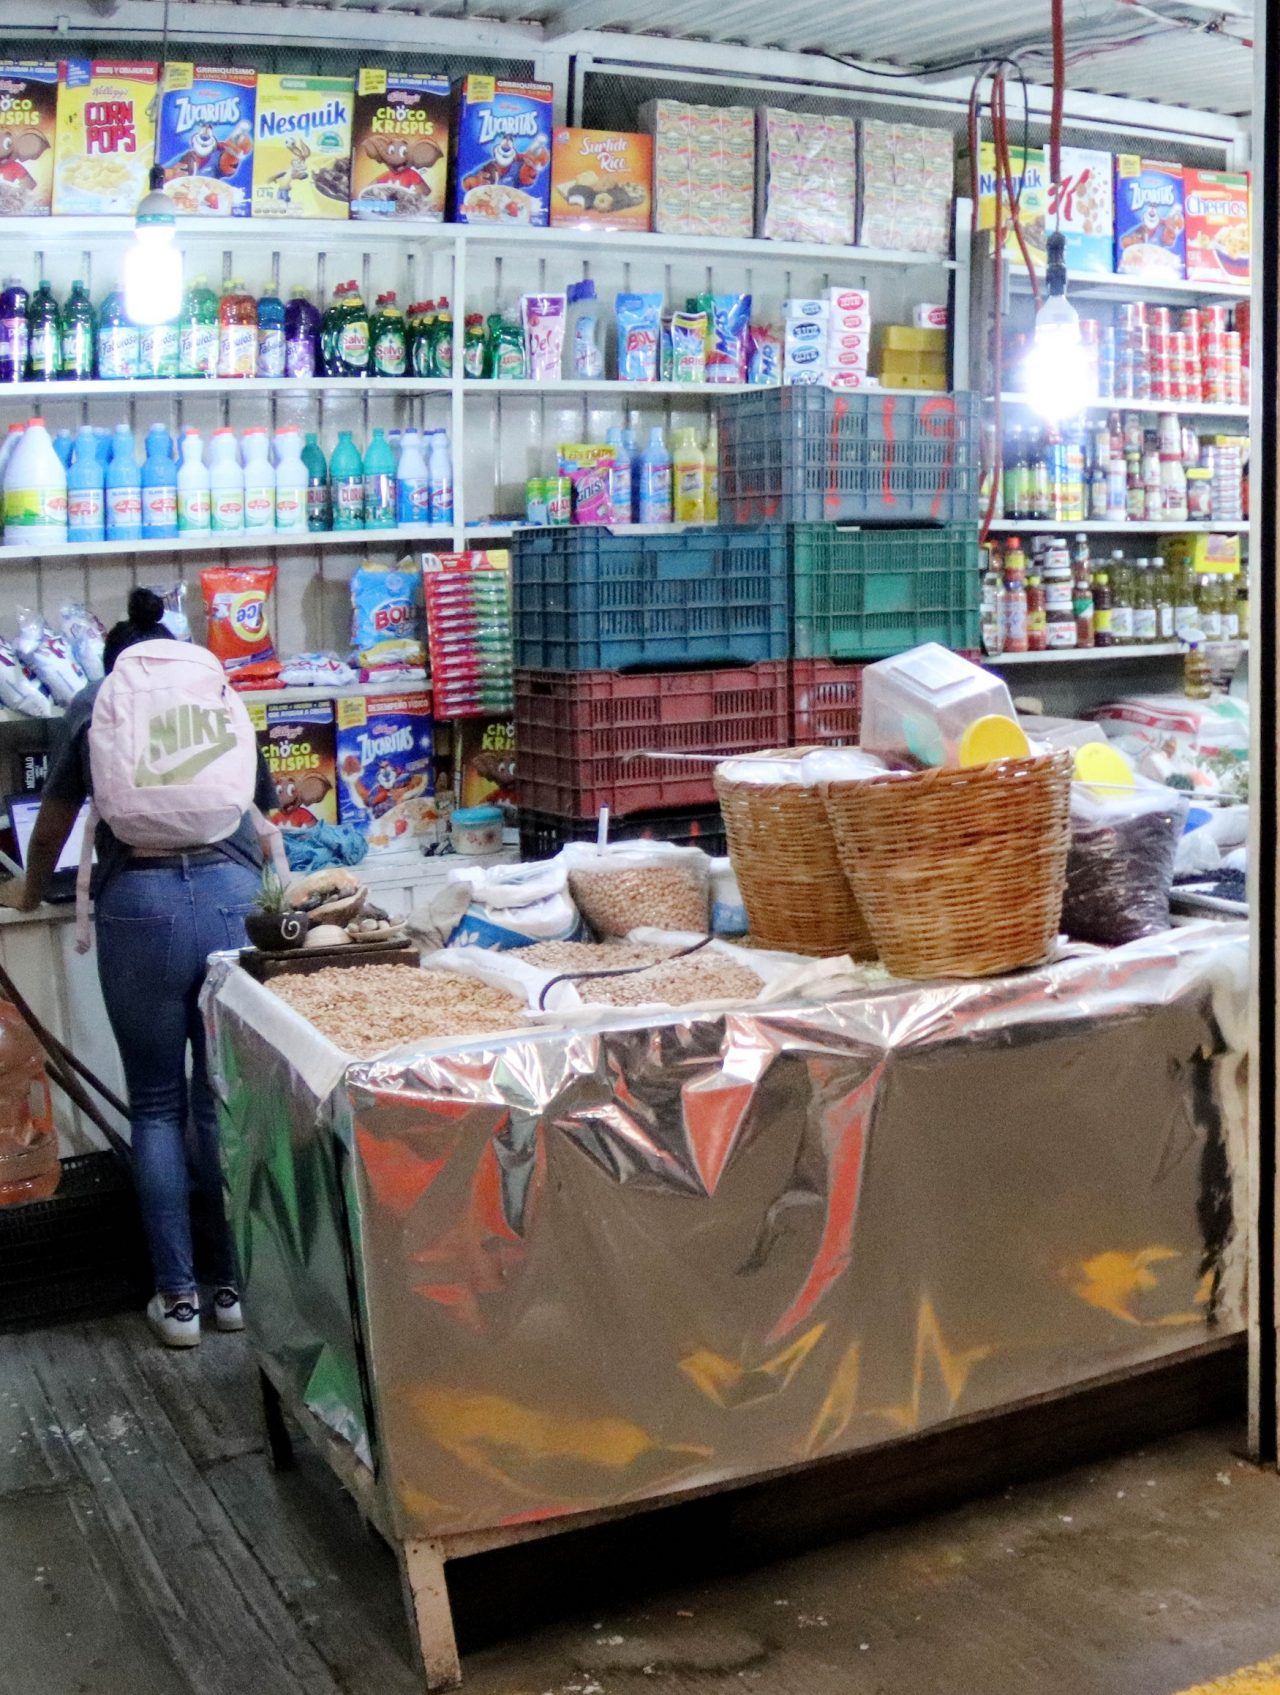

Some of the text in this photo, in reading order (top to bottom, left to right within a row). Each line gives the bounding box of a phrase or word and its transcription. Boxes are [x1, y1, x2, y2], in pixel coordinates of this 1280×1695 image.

[85, 101, 133, 126] CORN
[176, 97, 240, 133] ZUCARITAS
[260, 101, 346, 138] Nesquik
[372, 116, 434, 135] KRISPIS
[479, 109, 538, 144] ZUCARITAS
[87, 125, 136, 154] POPS
[1187, 195, 1247, 215] Cheerios
[148, 704, 233, 762] NIKE
[357, 725, 414, 766] ZUCARITAS
[266, 754, 320, 773] RISPIS
